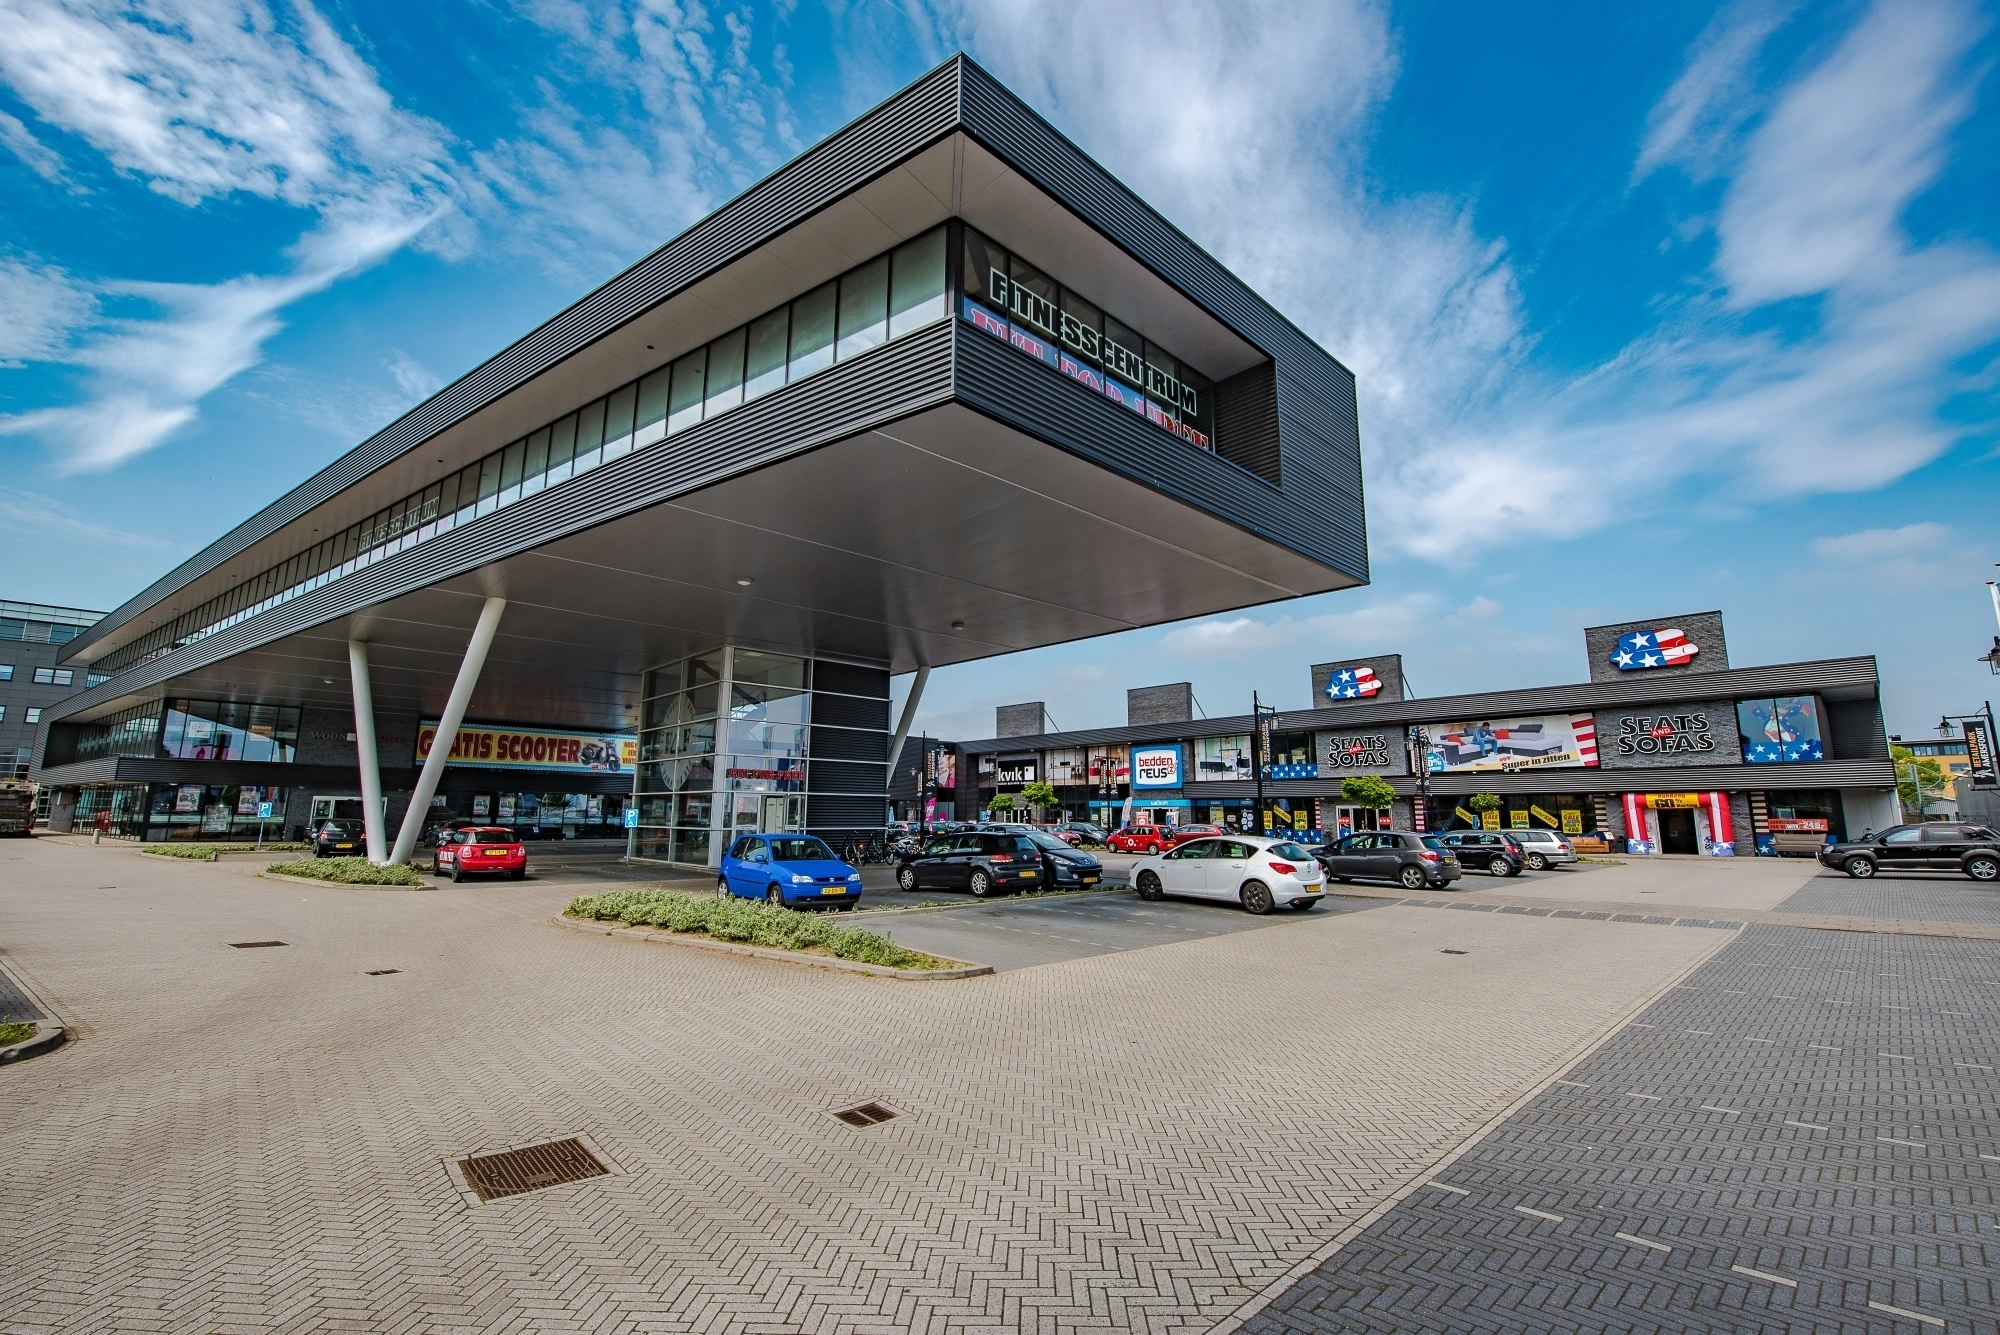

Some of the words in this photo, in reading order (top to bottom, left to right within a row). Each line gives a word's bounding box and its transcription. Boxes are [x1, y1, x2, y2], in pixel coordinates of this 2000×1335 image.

[989, 266, 1197, 417] FITNESSCENTRUM
[1619, 712, 1710, 736] SEATS
[1651, 727, 1671, 737] AND
[418, 730, 493, 759] GATIS
[496, 734, 582, 764] SCOOTER
[1329, 734, 1387, 752] SEATS
[1617, 732, 1715, 755] SOFAS
[1967, 731, 1982, 768] RETAILPARK
[1975, 727, 1991, 767] AMERSFOORT
[1138, 755, 1174, 768] bedden
[1327, 750, 1390, 768] SOFAS
[1501, 759, 1530, 770] Super
[1531, 757, 1541, 765] in
[1542, 753, 1571, 764] zitten
[998, 766, 1023, 781] kvik
[1139, 768, 1168, 779] reus
[261, 804, 269, 812] P
[627, 811, 636, 821] P
